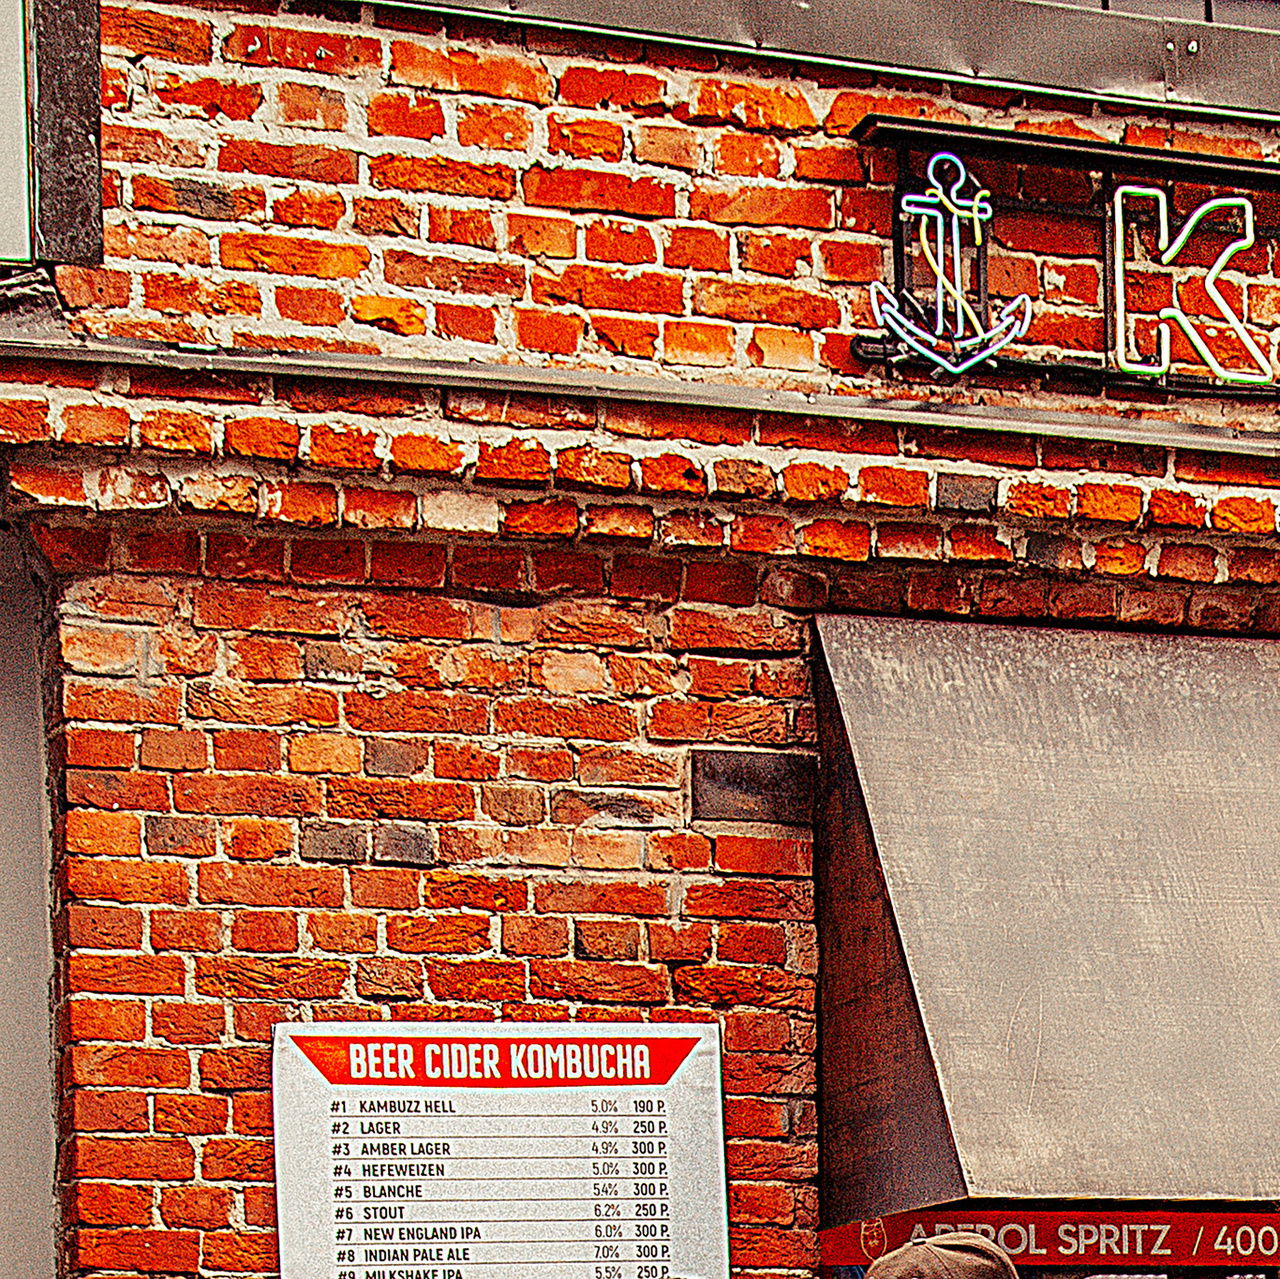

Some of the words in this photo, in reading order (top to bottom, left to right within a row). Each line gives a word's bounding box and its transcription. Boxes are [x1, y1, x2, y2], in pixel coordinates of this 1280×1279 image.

[350, 1043, 416, 1079] BEER
[424, 1043, 502, 1079] CIDER
[510, 1043, 651, 1079] KOMBUCHA
[330, 1100, 346, 1113] #1
[359, 1100, 421, 1113] KAMBUZZ
[424, 1100, 456, 1113] HELL
[591, 1100, 618, 1113] 5.0%
[633, 1100, 653, 1113] 190
[331, 1122, 350, 1135] #2
[360, 1122, 401, 1134] LAGER
[591, 1121, 619, 1134] 4.9%
[633, 1121, 655, 1134] 250
[331, 1143, 350, 1156] #3
[361, 1143, 407, 1155] AMBER
[410, 1143, 451, 1155] LAGER
[591, 1141, 619, 1155] 4.9%
[631, 1141, 654, 1155] 300
[333, 1164, 352, 1177] #4
[362, 1164, 445, 1177] HEFEWEIZEN
[592, 1162, 620, 1175] 5.0%
[632, 1162, 655, 1175] 300
[333, 1186, 353, 1198] #5
[363, 1185, 423, 1198] BLANCHE
[593, 1183, 618, 1196] 5.4%
[633, 1183, 656, 1196] 300
[335, 1207, 353, 1219] #6
[363, 1206, 405, 1219] STOUT
[594, 1204, 621, 1217] 6.2%
[635, 1203, 657, 1216] 250
[336, 1228, 353, 1241] #7
[363, 1228, 394, 1240] NEW
[398, 1227, 457, 1240] ENGLAND
[461, 1227, 481, 1239] IPA
[594, 1225, 622, 1238] 6.0%
[634, 1225, 657, 1237] 300
[1057, 1224, 1171, 1254] SPRITZ
[1213, 1225, 1279, 1255] 400
[336, 1250, 355, 1262] #8
[364, 1249, 409, 1262] INDIAN
[413, 1249, 443, 1261] PALE
[447, 1248, 470, 1261] ALE
[594, 1245, 620, 1258] 7.0%
[635, 1245, 658, 1258] 300
[594, 1266, 622, 1279] 5.5%
[637, 1266, 658, 1279] 250
